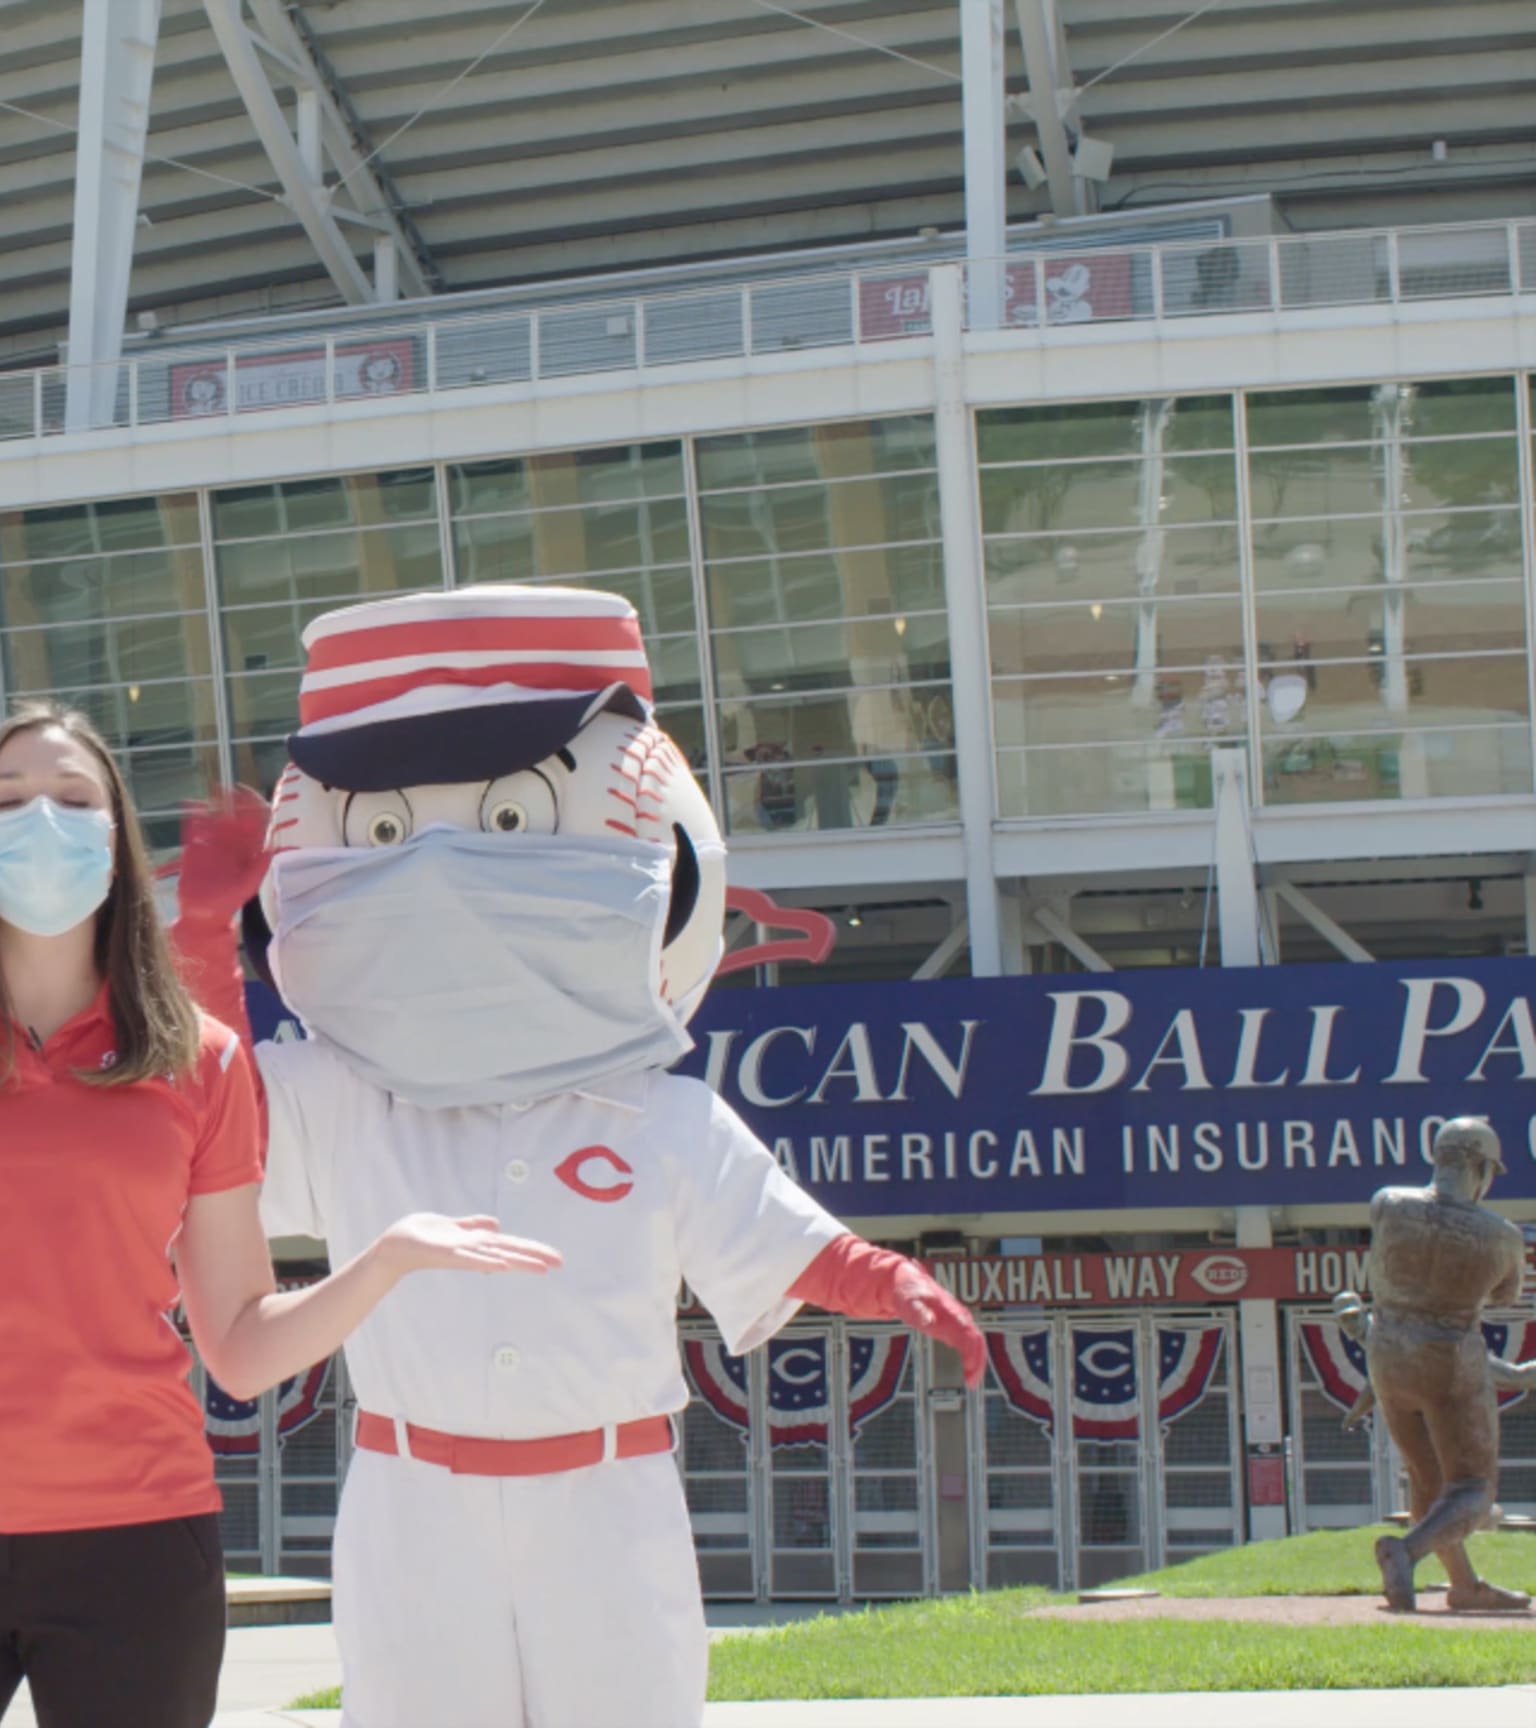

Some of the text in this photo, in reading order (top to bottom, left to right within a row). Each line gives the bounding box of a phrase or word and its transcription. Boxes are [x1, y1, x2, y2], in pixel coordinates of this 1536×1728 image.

[1380, 977, 1536, 1084] PA
[772, 1127, 1085, 1184] AMERICAN
[1122, 1115, 1490, 1174] INSURANC
[934, 1255, 1180, 1303] NUXHALL WAY
[1295, 1250, 1372, 1294] HOM
